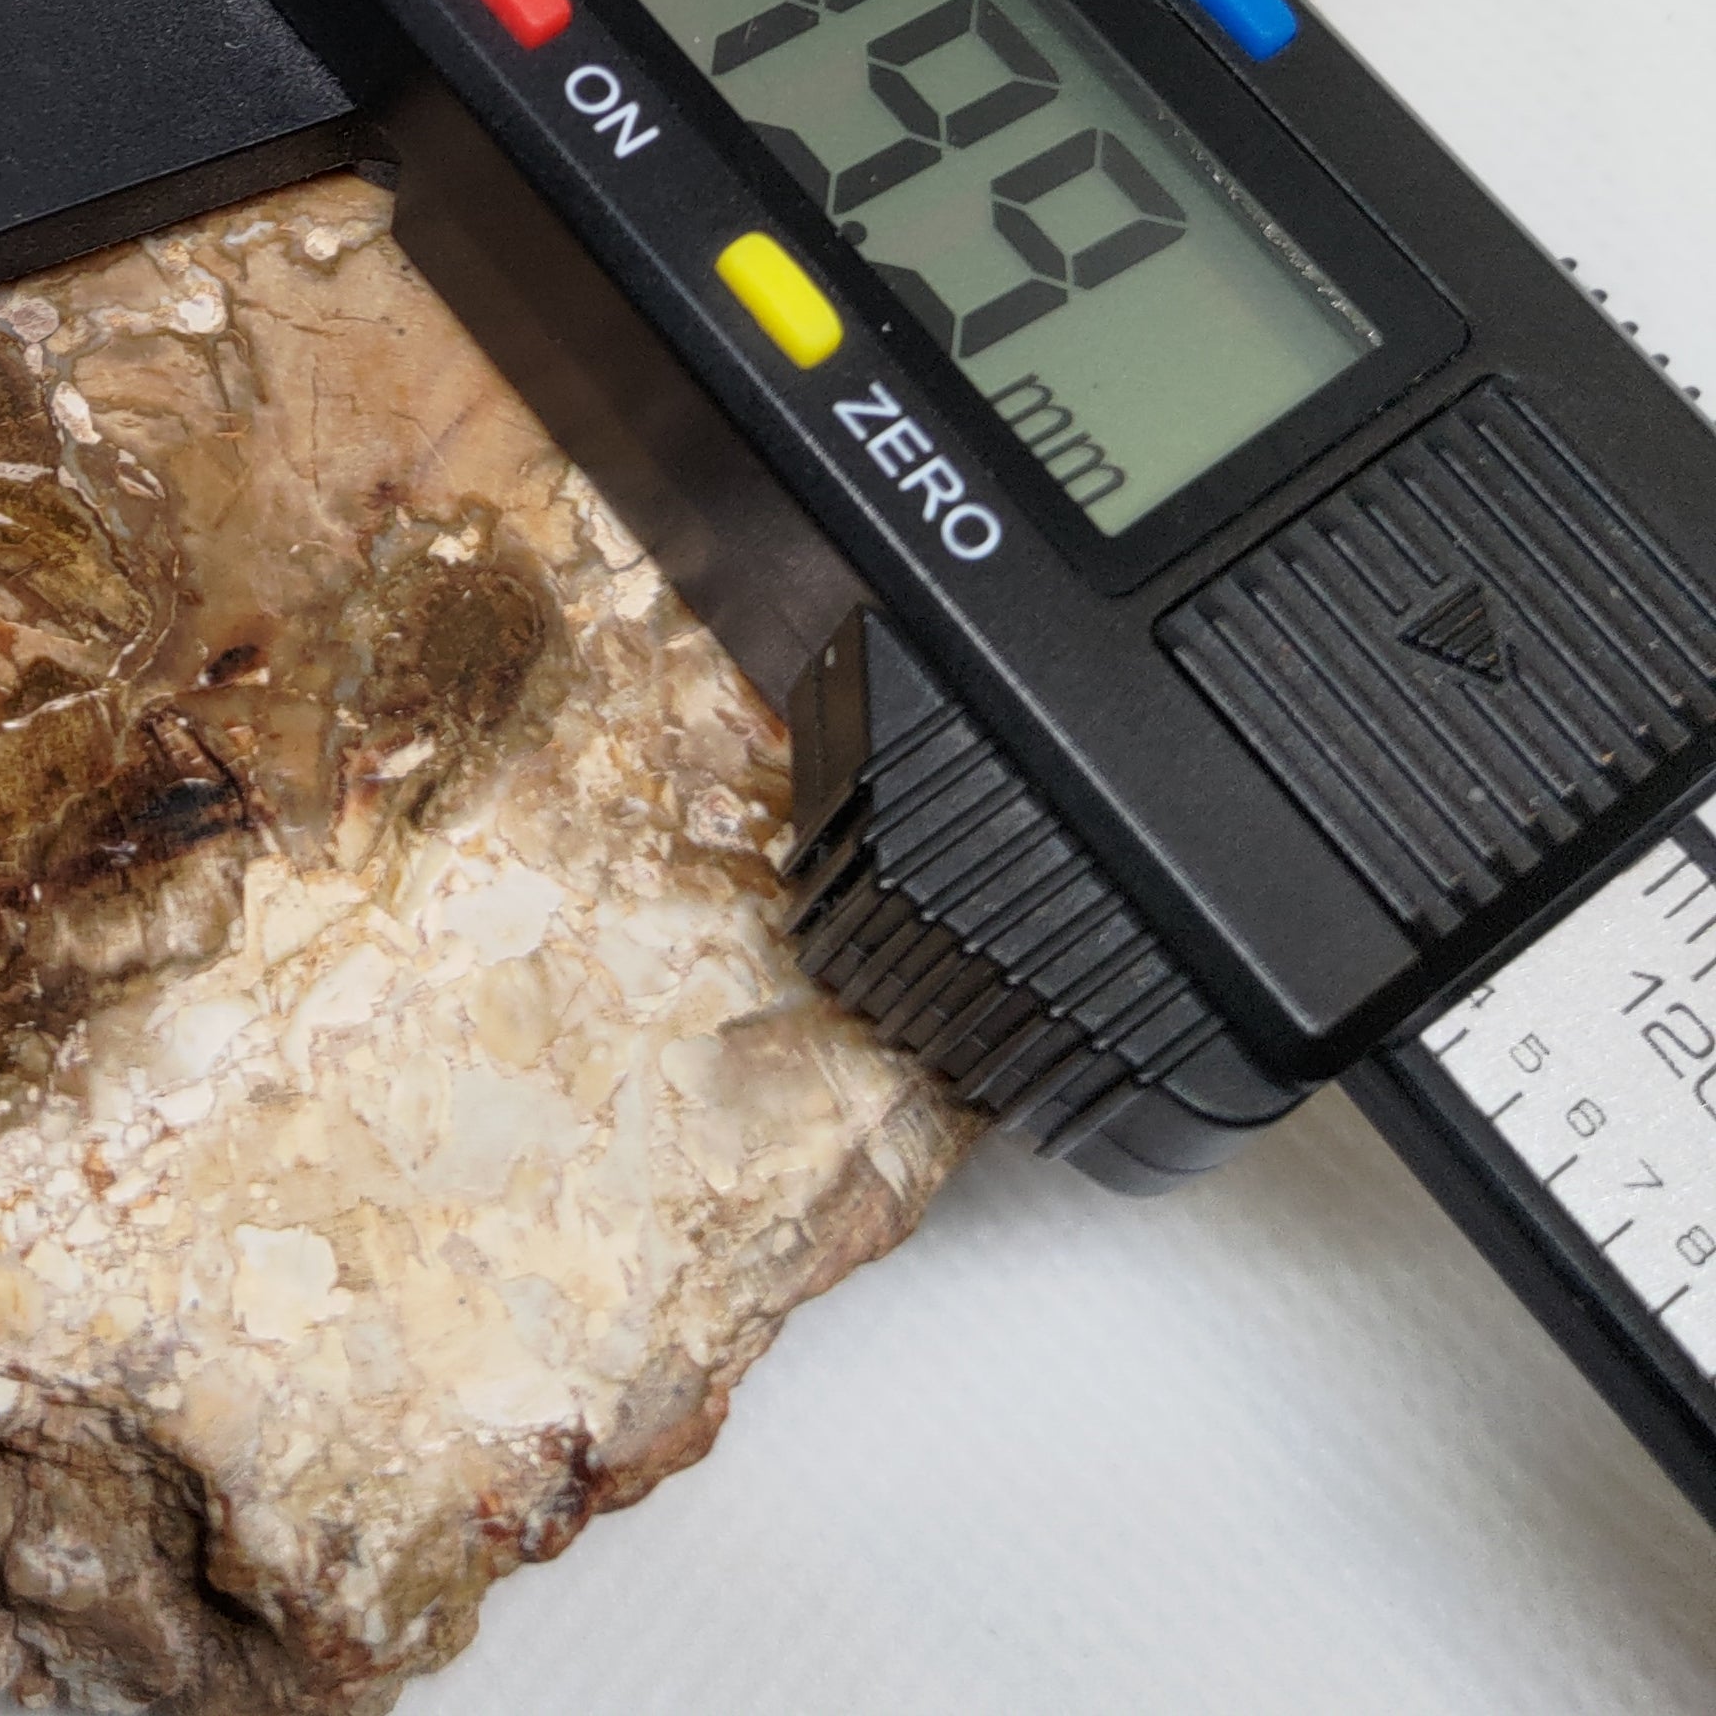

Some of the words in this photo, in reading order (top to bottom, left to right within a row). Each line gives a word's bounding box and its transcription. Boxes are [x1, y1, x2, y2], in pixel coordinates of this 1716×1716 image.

[565, 62, 661, 160] ON
[832, 381, 1003, 562] ZERO
[989, 372, 1126, 506] mm
[1508, 1032, 1550, 1073] 5
[1566, 1097, 1607, 1137] 6
[1623, 1158, 1664, 1188] 7
[1675, 1224, 1716, 1267] 8
